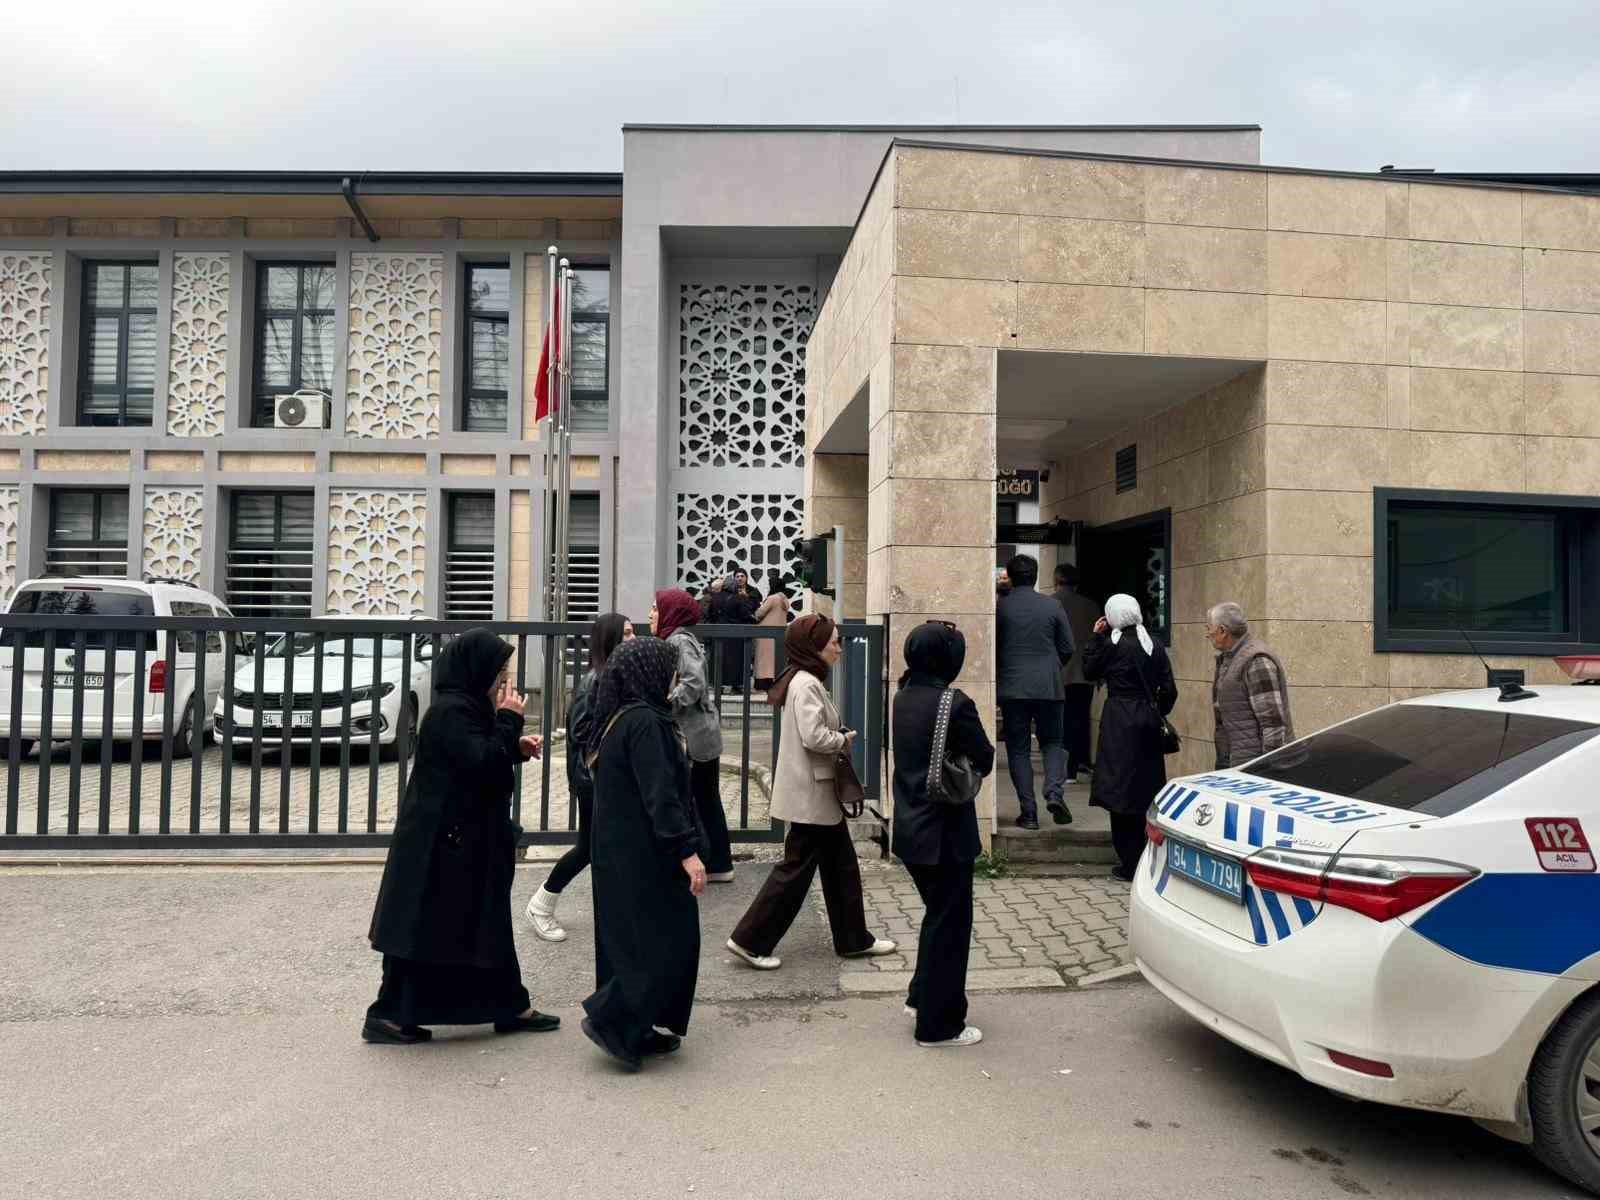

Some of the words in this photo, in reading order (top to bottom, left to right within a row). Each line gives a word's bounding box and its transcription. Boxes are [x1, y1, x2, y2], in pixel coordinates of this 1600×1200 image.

[998, 479, 1032, 495] ÜĞÜ
[1268, 790, 1388, 823] POLİSİ
[1534, 822, 1582, 848] 112
[1173, 844, 1187, 870] 54
[1194, 852, 1202, 877] A
[1210, 859, 1241, 893] 7794
